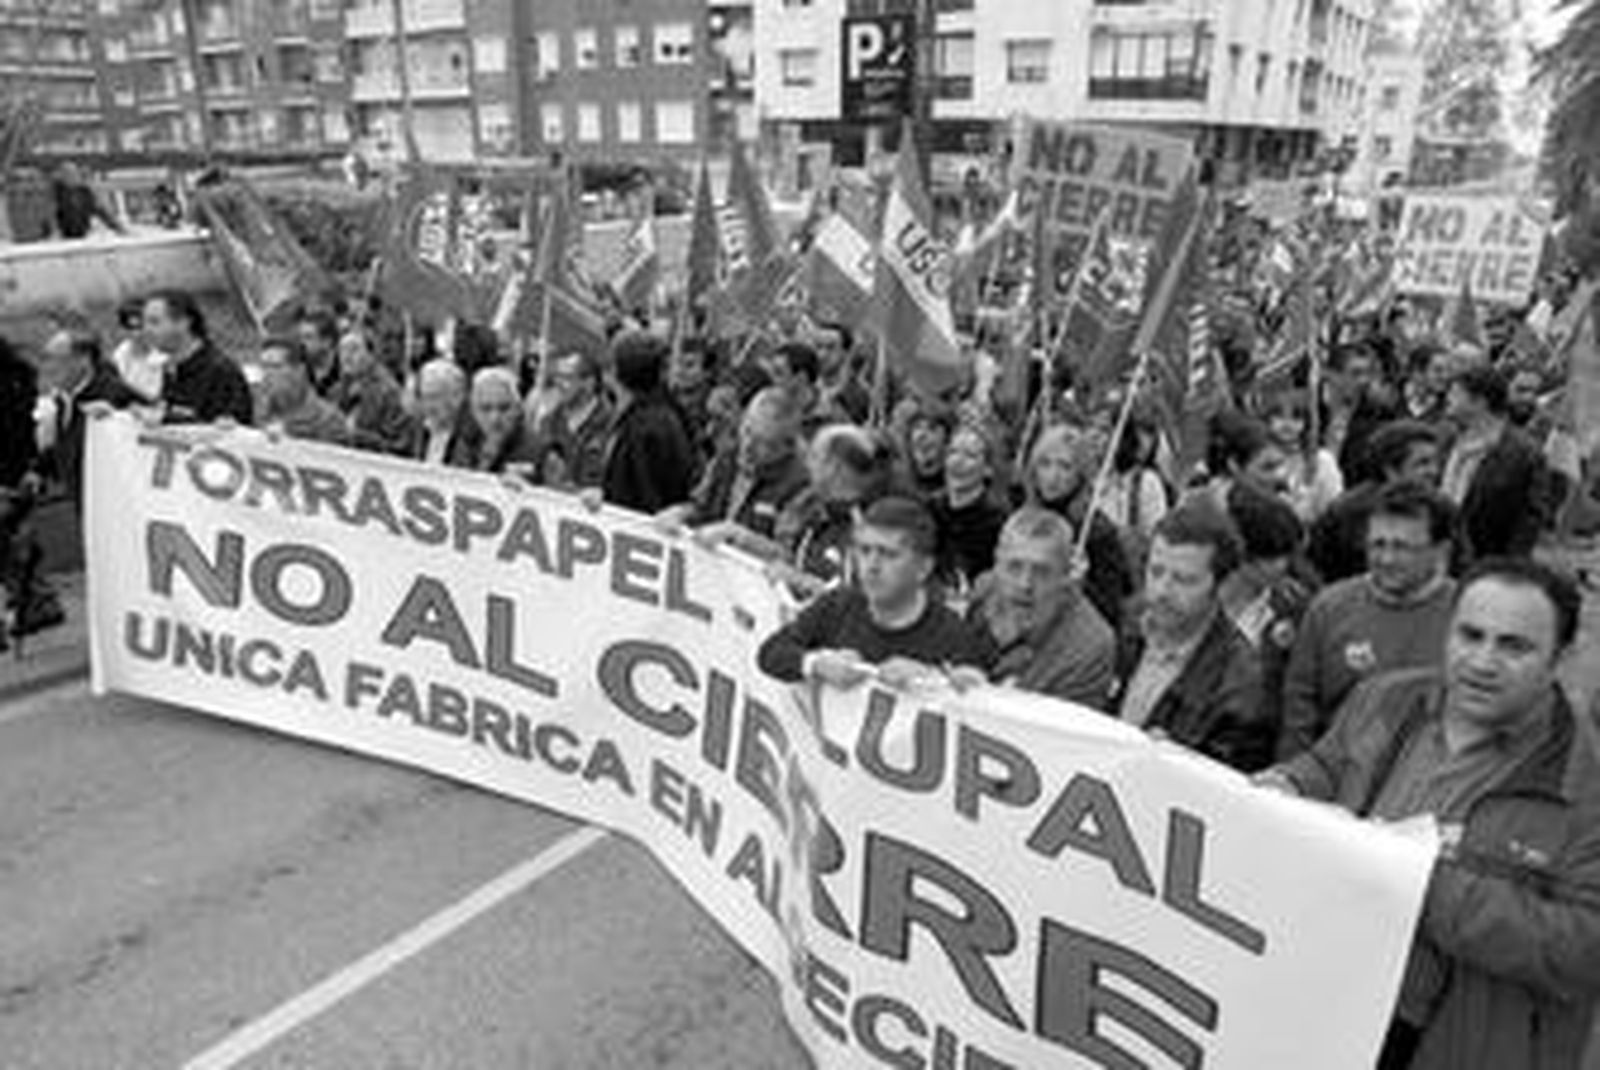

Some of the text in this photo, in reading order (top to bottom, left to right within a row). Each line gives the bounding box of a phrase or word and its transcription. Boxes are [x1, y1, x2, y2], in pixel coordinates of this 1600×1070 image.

[1030, 124, 1167, 191] NO AL
[1407, 205, 1466, 242] NO
[1480, 212, 1530, 245] AL
[137, 434, 712, 622] TORRASPAPEL
[124, 612, 328, 700] UNICA
[344, 662, 636, 796] FABRICA
[651, 757, 723, 858] EN
[145, 520, 1220, 1070] NO AL CIERRE
